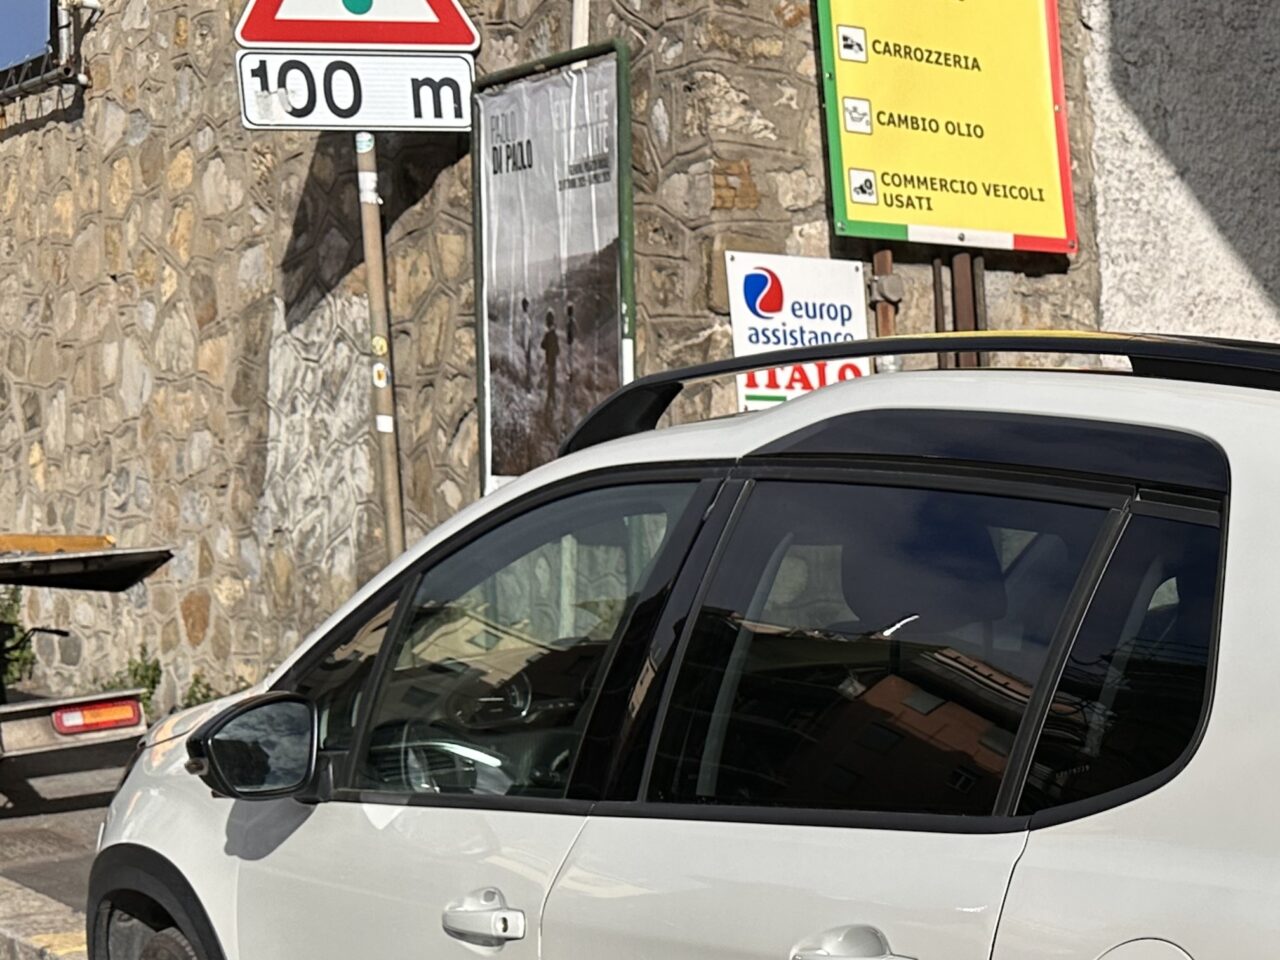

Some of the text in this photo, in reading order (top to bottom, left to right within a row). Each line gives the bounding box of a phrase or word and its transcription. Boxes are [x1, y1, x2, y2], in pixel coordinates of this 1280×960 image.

[871, 39, 982, 72] CARROZZERIA
[250, 58, 464, 119] 100 m
[876, 110, 985, 140] CAMBIO OLIO
[492, 146, 503, 175] DI
[505, 139, 533, 173] PAOLO
[880, 172, 1045, 202] COMMERCIO VEICOLI
[883, 192, 934, 212] USATI
[791, 300, 853, 327] europ
